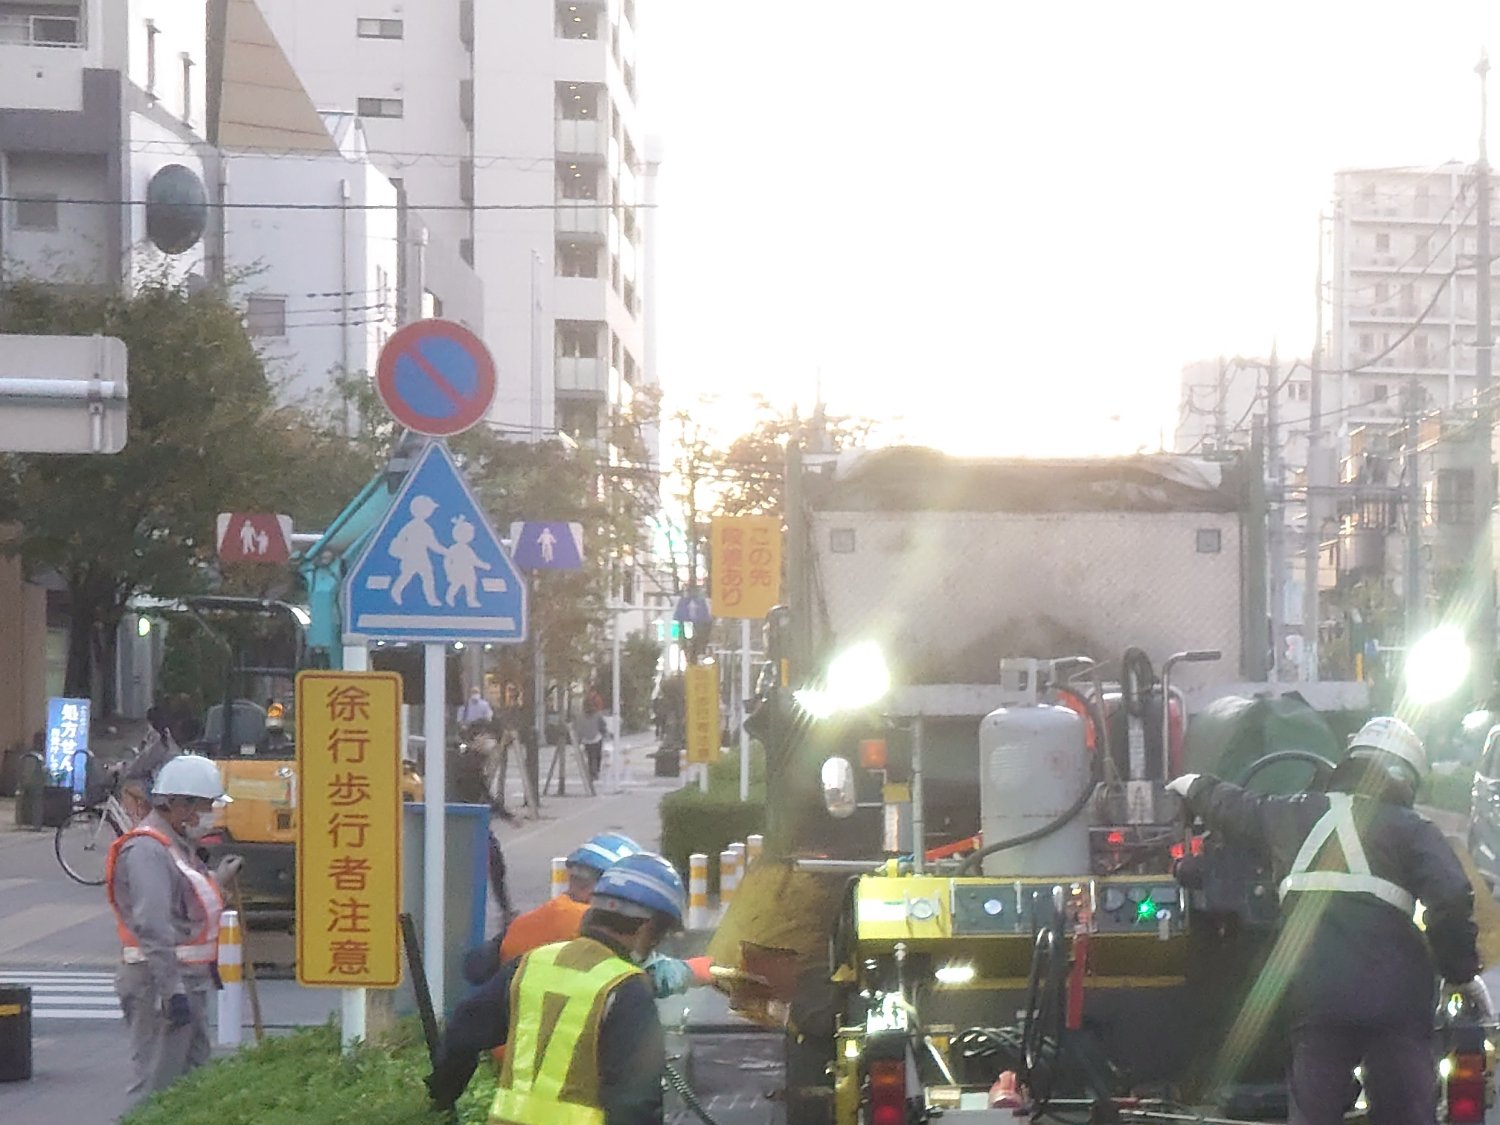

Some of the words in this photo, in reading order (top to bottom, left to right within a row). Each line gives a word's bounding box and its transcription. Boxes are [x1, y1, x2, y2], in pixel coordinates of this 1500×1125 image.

[326, 685, 372, 976] 徐行歩行者注意
